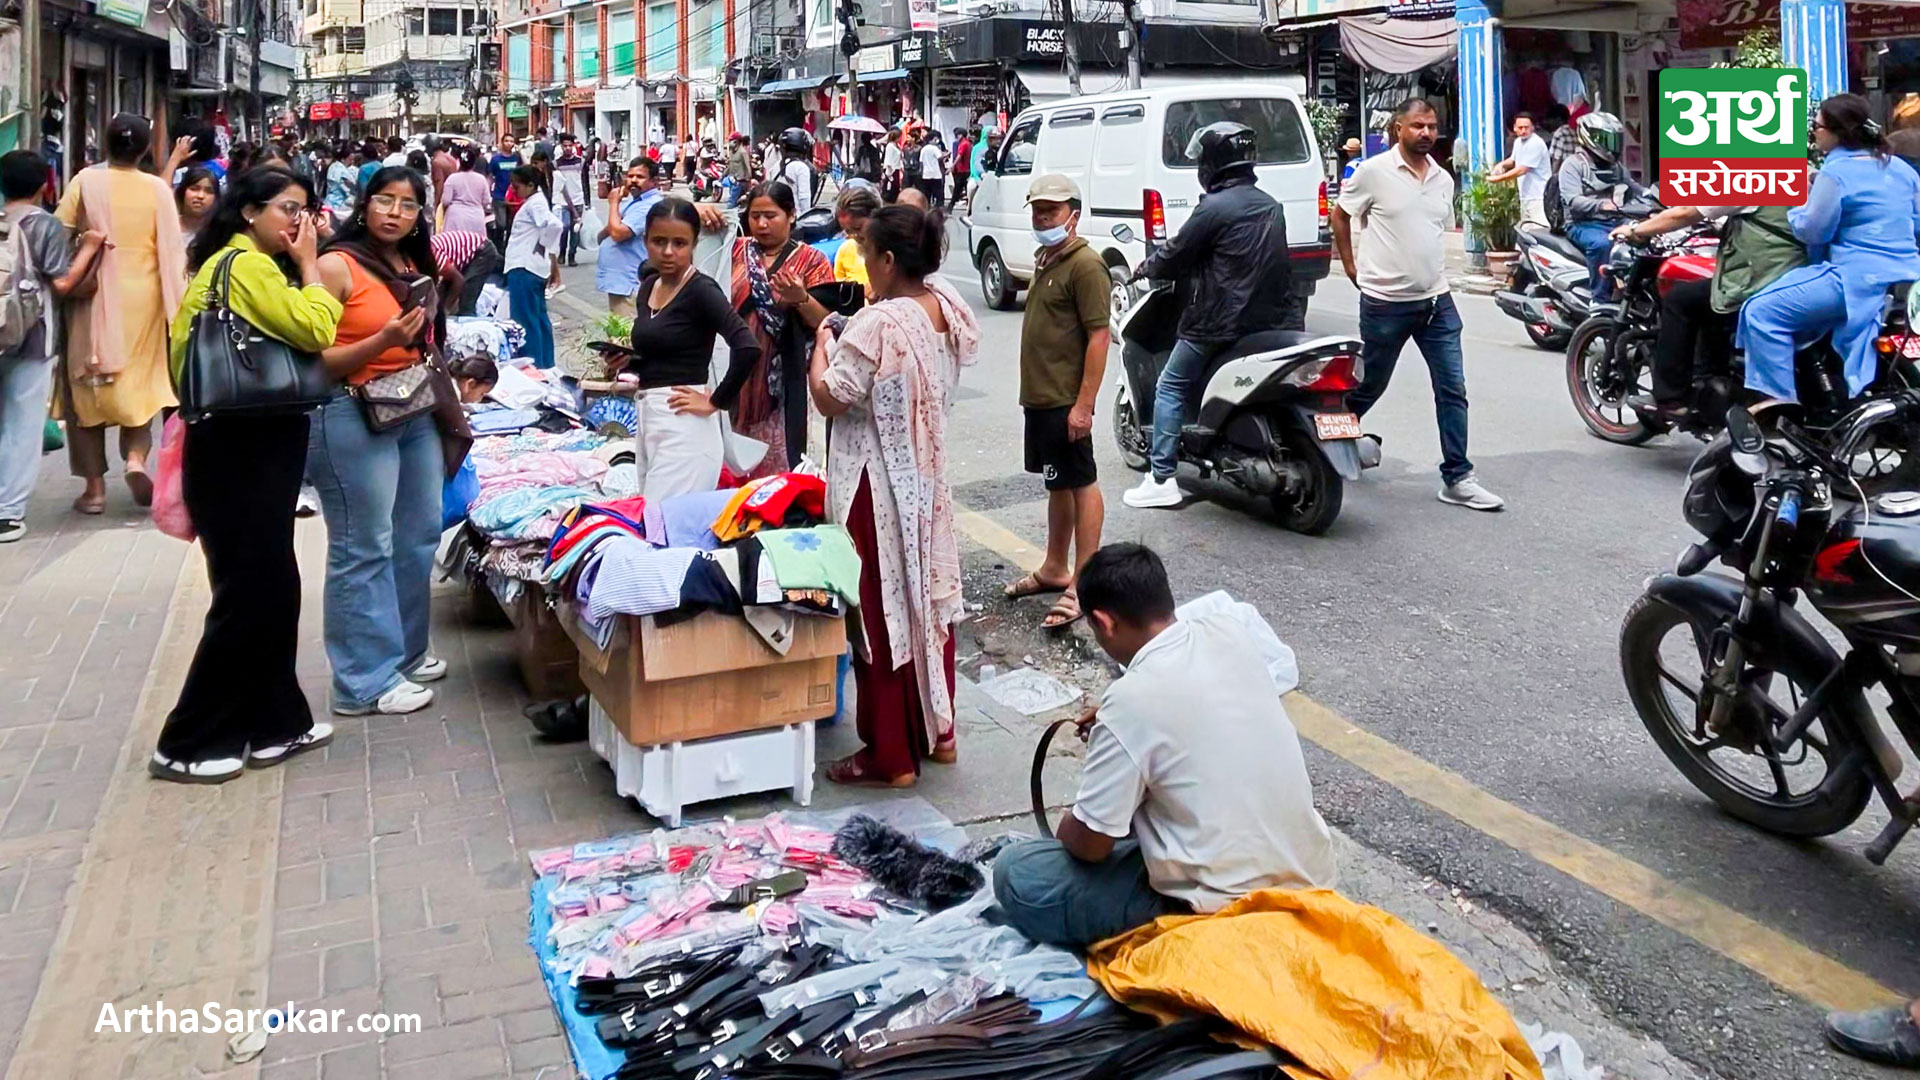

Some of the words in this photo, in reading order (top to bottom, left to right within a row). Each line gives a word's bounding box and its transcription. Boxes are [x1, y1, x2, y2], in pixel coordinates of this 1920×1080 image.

[1026, 28, 1065, 40] BLACK
[902, 37, 922, 50] BLACK
[1026, 40, 1064, 52] HORSE
[902, 50, 922, 61] HORSE
